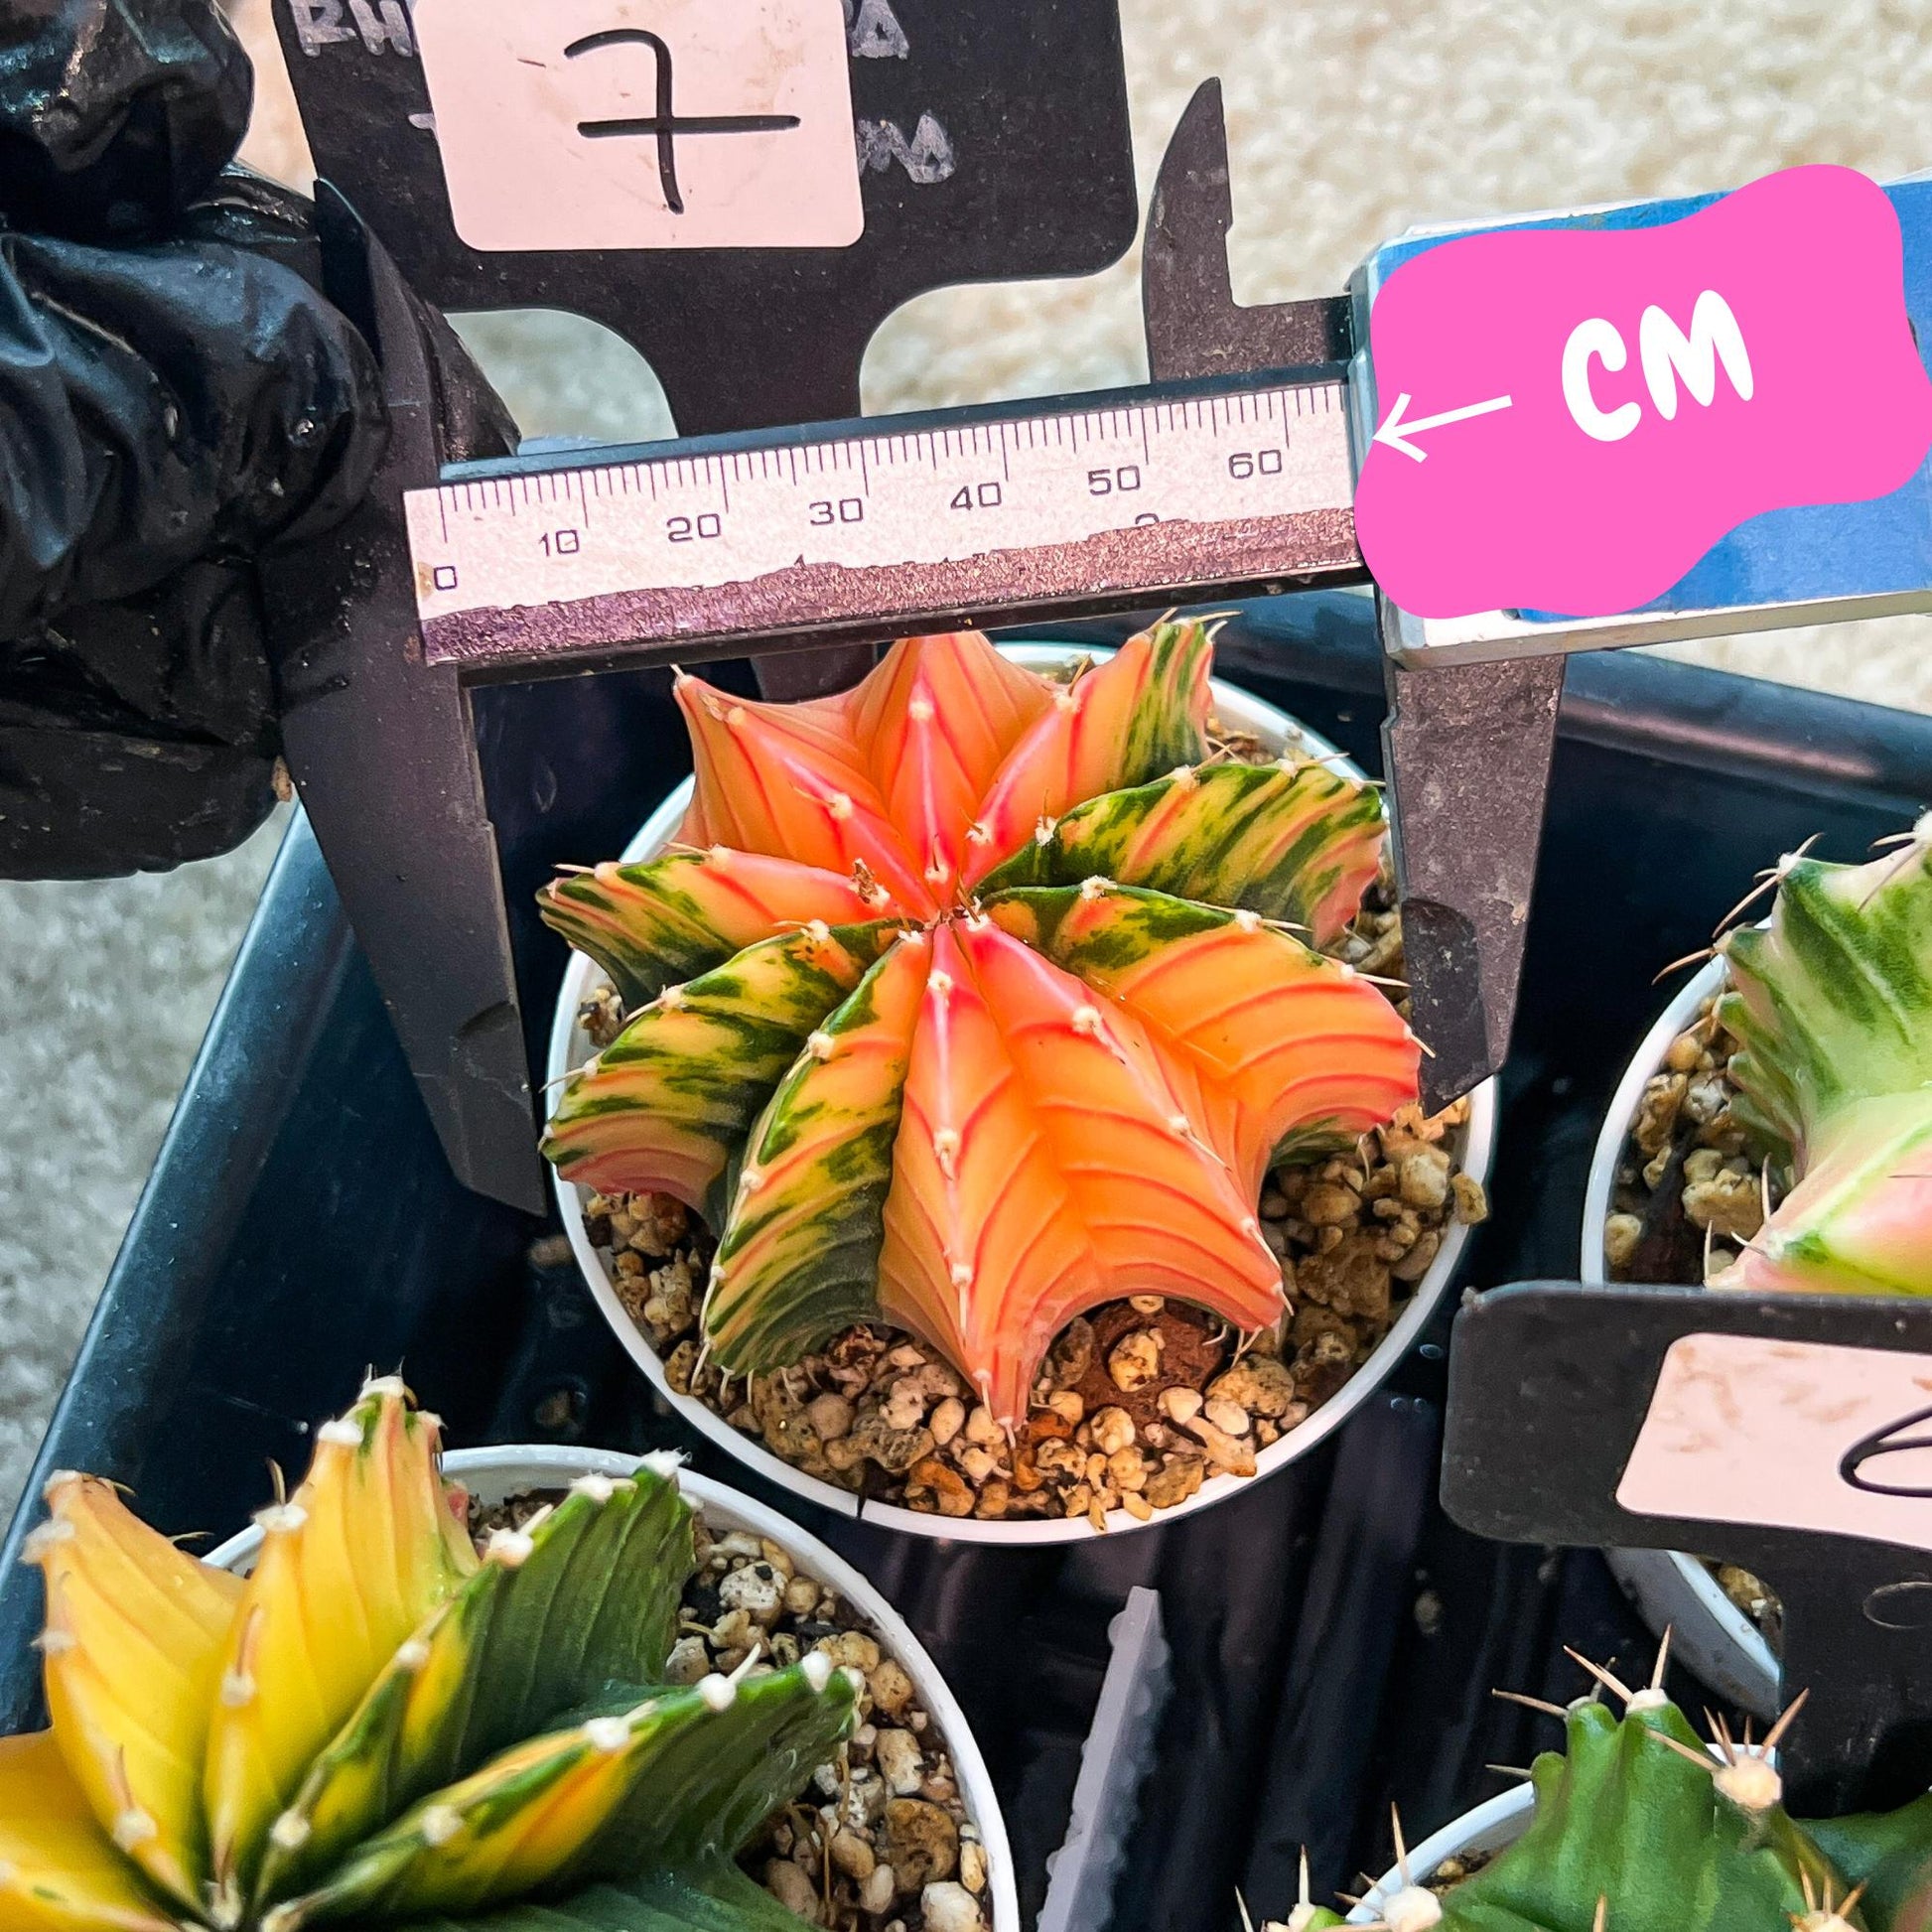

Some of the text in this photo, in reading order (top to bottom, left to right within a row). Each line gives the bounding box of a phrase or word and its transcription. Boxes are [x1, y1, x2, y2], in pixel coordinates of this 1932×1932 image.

[434, 450, 1283, 591] 0 10 20 30 40 50 60
